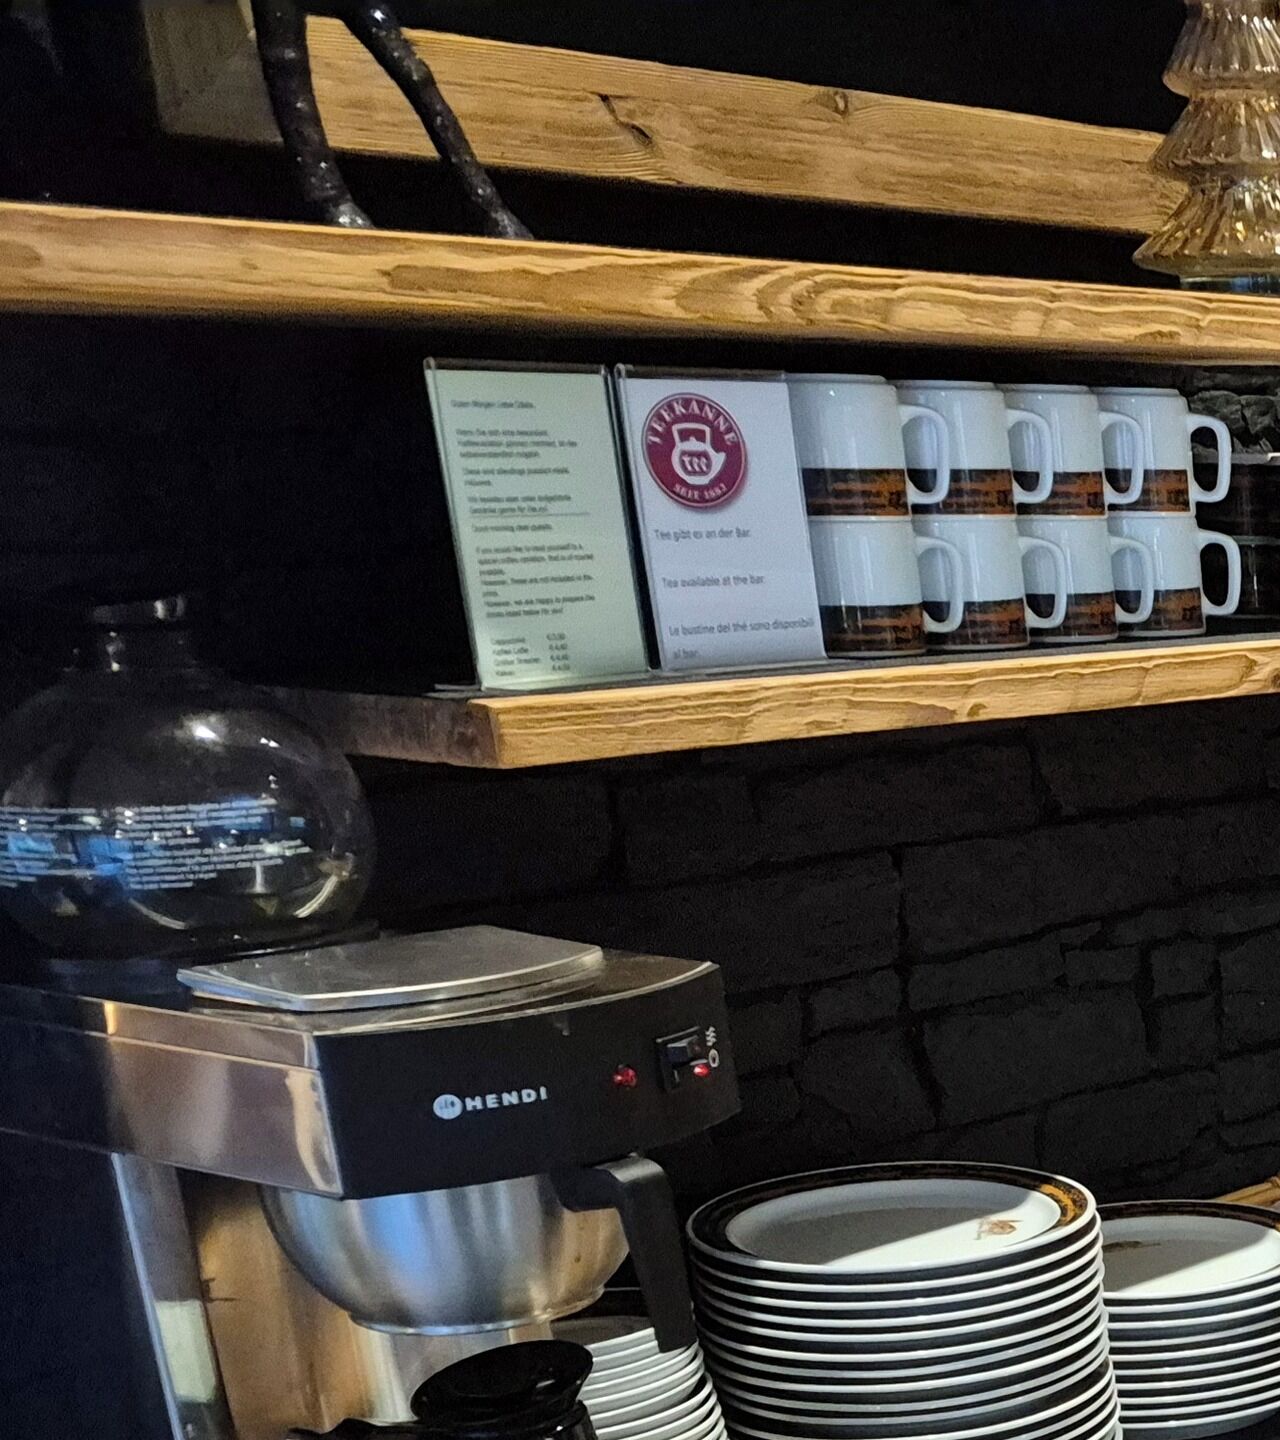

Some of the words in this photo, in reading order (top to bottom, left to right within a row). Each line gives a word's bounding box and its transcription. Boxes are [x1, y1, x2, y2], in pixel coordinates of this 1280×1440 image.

[646, 399, 739, 446] TEEKANNE
[654, 529, 672, 540] Tee
[673, 529, 691, 542] gibt
[718, 527, 733, 538] der
[662, 577, 679, 588] Tea
[681, 575, 720, 588] available
[733, 575, 748, 585] the
[681, 624, 715, 636] bustine
[465, 1085, 549, 1112] HENDI
